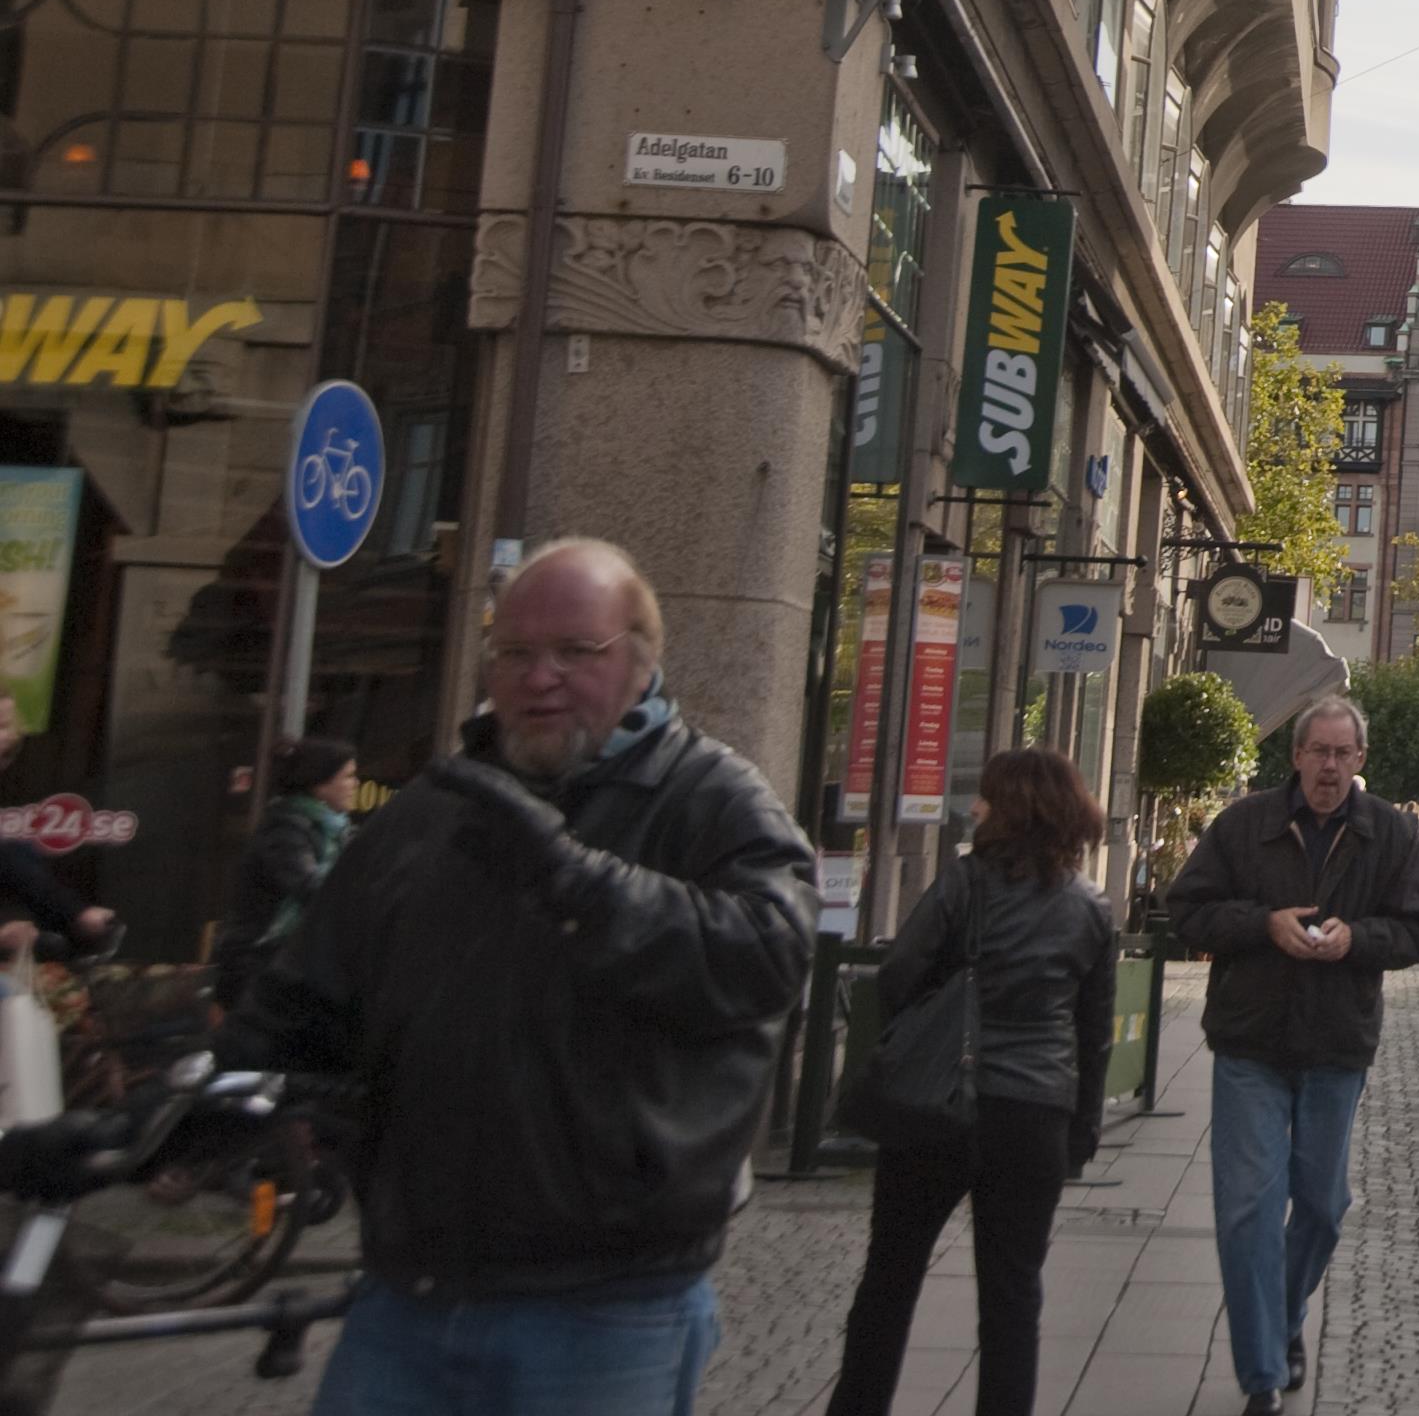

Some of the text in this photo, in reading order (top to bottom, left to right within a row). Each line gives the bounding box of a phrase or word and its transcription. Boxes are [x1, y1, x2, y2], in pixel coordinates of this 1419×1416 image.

[635, 136, 728, 164] Adelgatan
[727, 165, 775, 187] 6-10
[0, 293, 264, 389] WAY
[977, 210, 1049, 477] SUBWAY
[1044, 639, 1107, 653] Nordea
